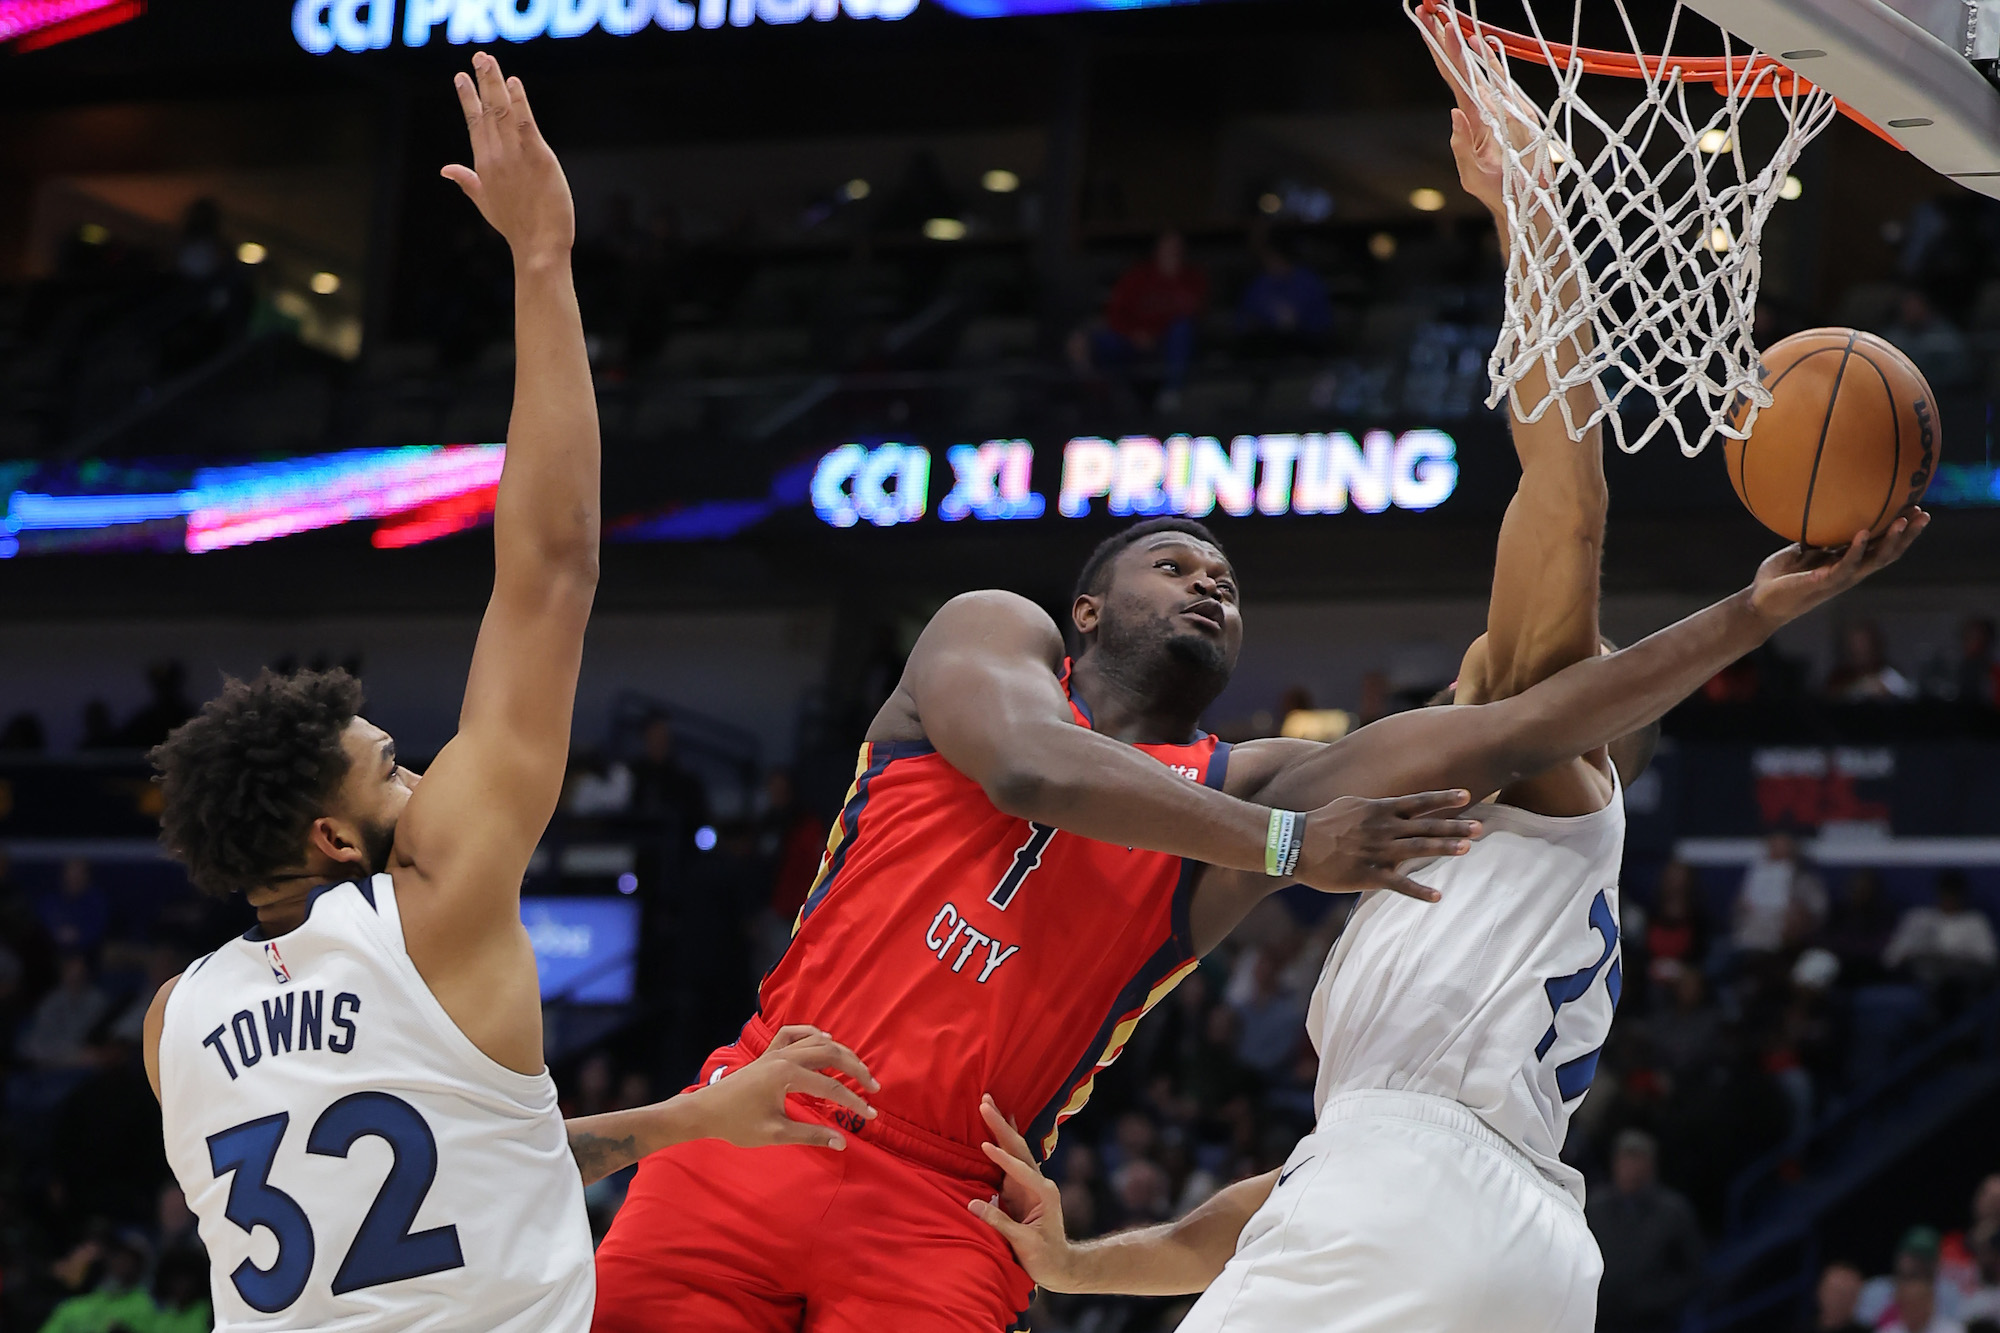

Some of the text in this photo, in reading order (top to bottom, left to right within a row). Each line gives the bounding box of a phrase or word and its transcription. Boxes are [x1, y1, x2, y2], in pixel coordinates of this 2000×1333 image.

[402, 0, 920, 48] PRODUC
[810, 429, 1460, 528] CCI XL PRINTING
[925, 902, 1020, 983] CITY
[202, 990, 361, 1081] TOWNS
[205, 1090, 465, 1314] 32
